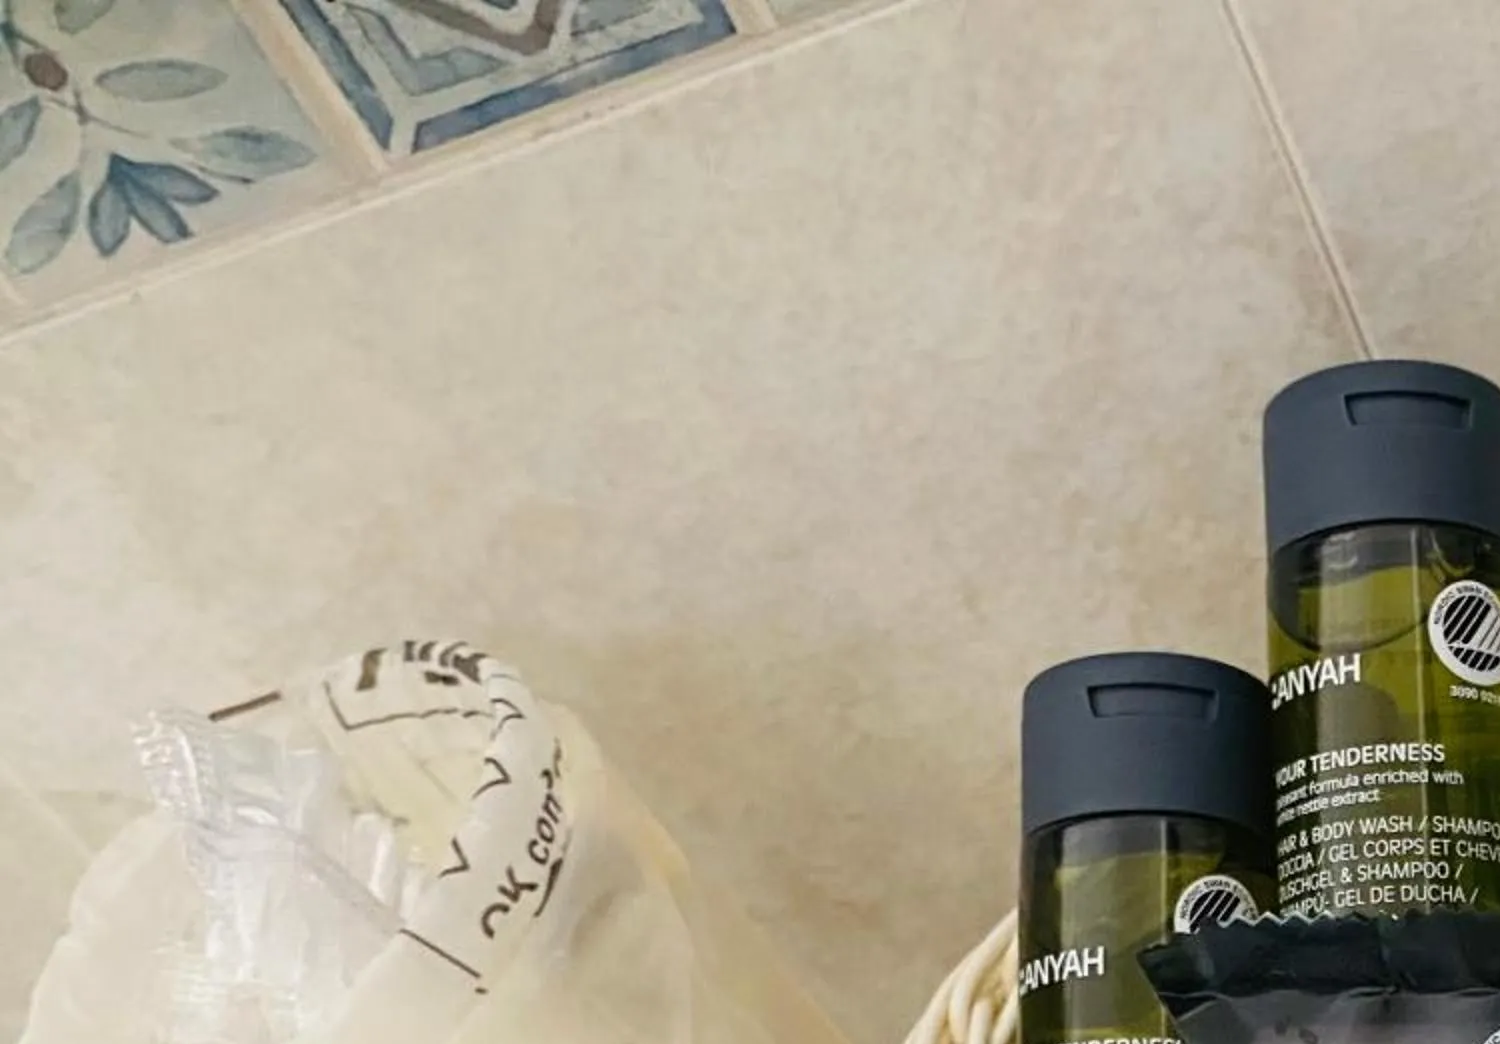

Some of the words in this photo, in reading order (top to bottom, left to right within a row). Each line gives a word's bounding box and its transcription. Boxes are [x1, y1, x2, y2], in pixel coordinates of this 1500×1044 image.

[1309, 743, 1445, 774] TENDERNESS
[1363, 769, 1428, 786] enriched
[1433, 769, 1464, 786] with
[1331, 789, 1381, 807] extract
[1311, 821, 1354, 844] BODY
[1359, 815, 1413, 835] WASH
[1418, 815, 1428, 832] /
[1317, 848, 1326, 865] /
[1328, 843, 1359, 864] GEL
[1363, 836, 1424, 858] CORPS
[1430, 837, 1452, 856] ET
[1340, 866, 1353, 884] &
[1357, 862, 1450, 883] SHAMPOO
[1455, 863, 1463, 881] /
[1334, 887, 1365, 908] GEL
[1370, 885, 1396, 904] DE
[1401, 885, 1465, 904] DUCHA
[1469, 887, 1479, 905] /
